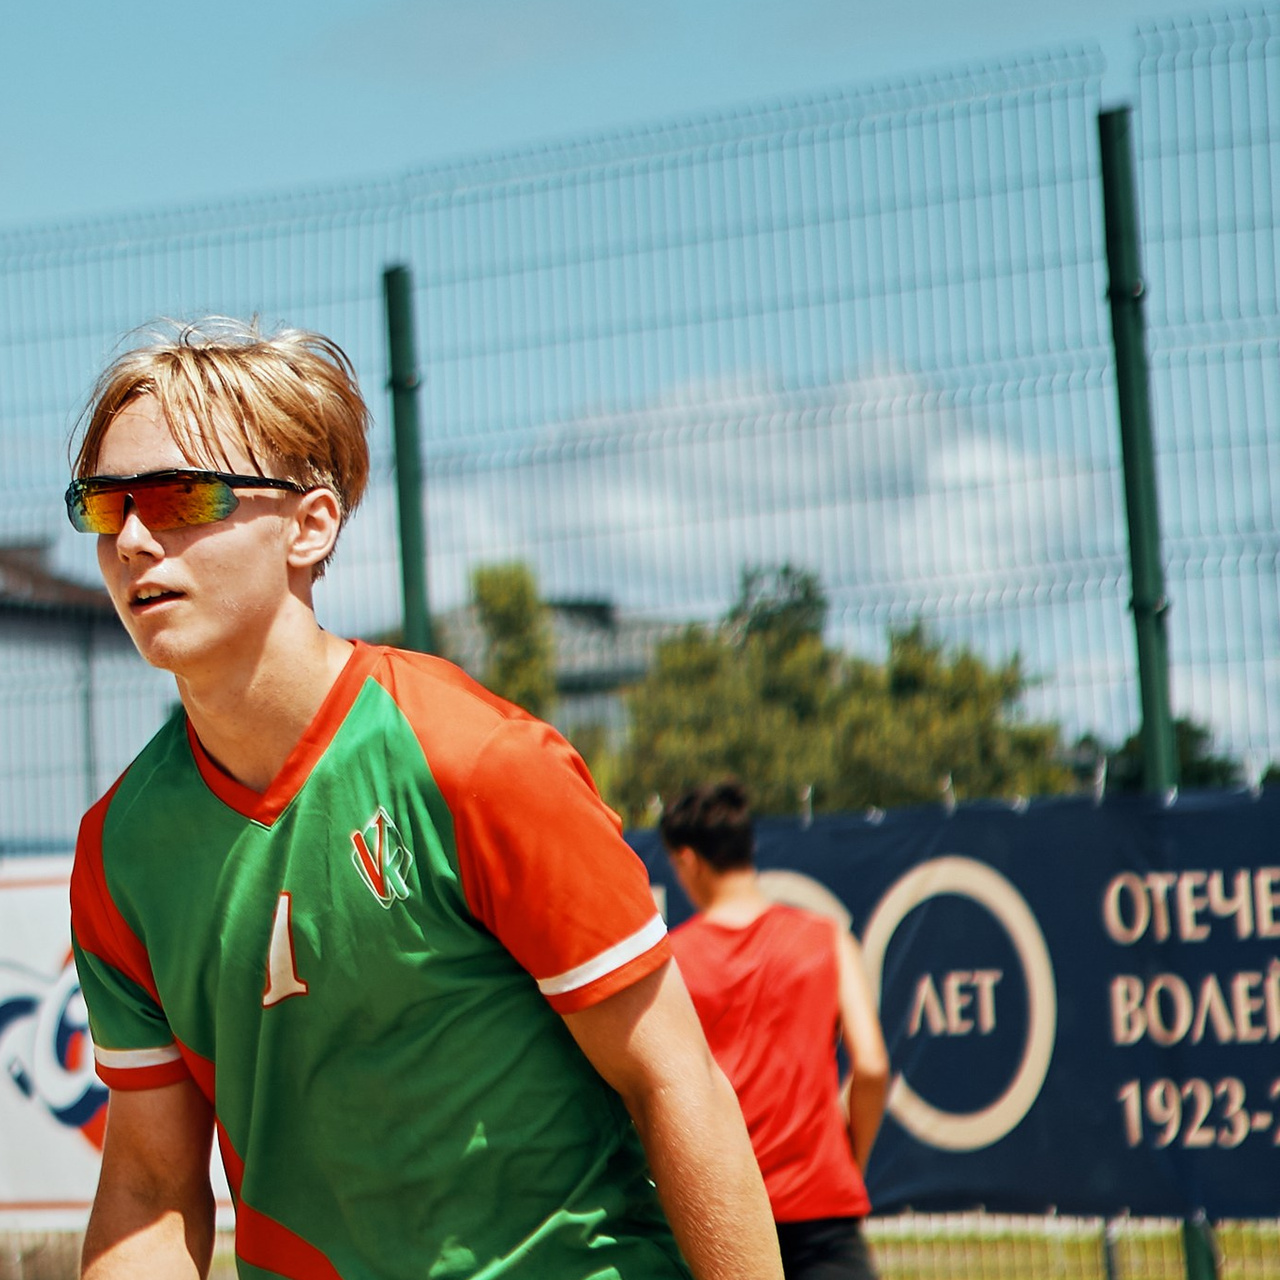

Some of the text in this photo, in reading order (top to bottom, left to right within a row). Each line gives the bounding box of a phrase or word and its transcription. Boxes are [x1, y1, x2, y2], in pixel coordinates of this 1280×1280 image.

[1104, 867, 1280, 945] ОТЕЧЕ
[262, 890, 308, 1008] 1
[908, 970, 1002, 1037] ЛЕТ
